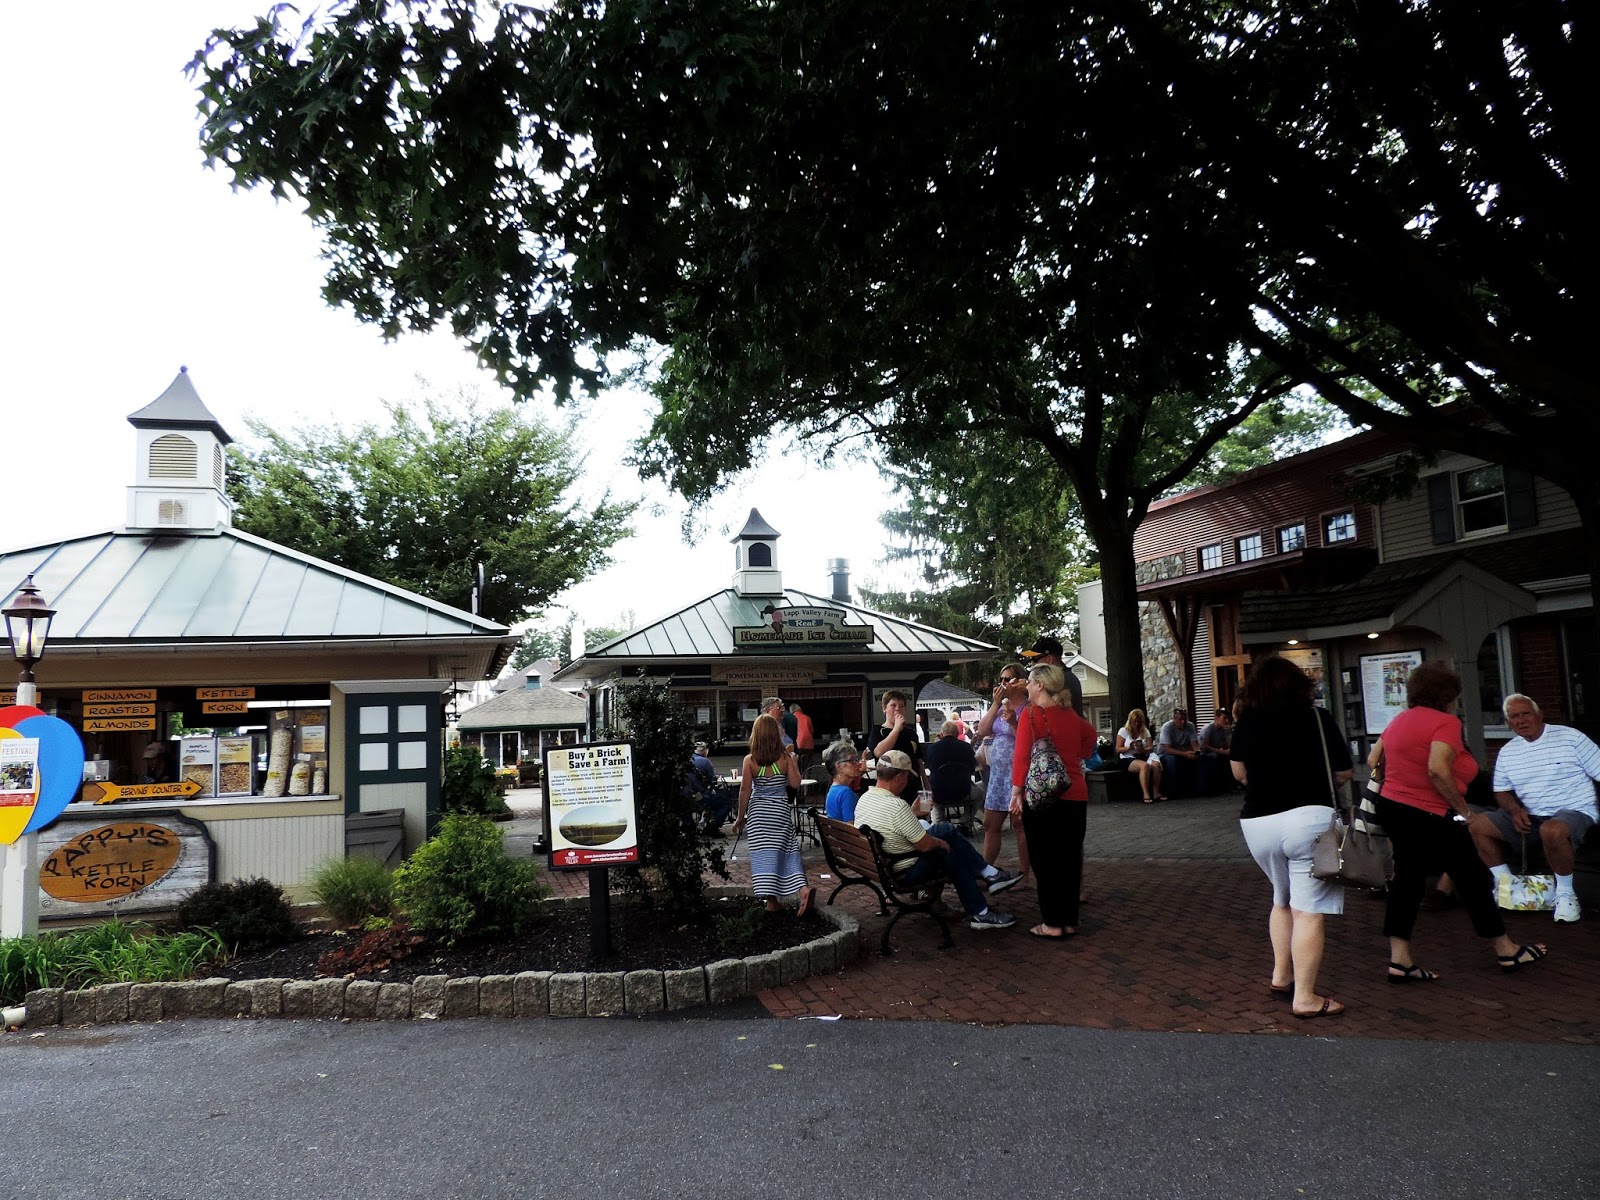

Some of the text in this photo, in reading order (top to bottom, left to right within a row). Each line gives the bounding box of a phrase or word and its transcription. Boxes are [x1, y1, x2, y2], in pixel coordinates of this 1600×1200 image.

[802, 609, 821, 617] Valley
[824, 610, 840, 618] Farm
[741, 630, 867, 641] HOMEMADE ICE CREAM
[88, 691, 152, 700] CINNAMON
[201, 689, 249, 698] KETTLE
[89, 706, 150, 715] ROASTED
[207, 704, 243, 712] KORN
[89, 720, 150, 730] ALMONDS
[568, 750, 586, 761] Buy
[597, 747, 622, 758] Brick
[568, 759, 591, 769] Save
[602, 756, 630, 767] Farm!
[120, 784, 182, 796] SERVING COUNTER
[45, 826, 170, 876] PAPPY'S
[71, 859, 155, 878] KETTLE
[84, 873, 147, 890] KORN
